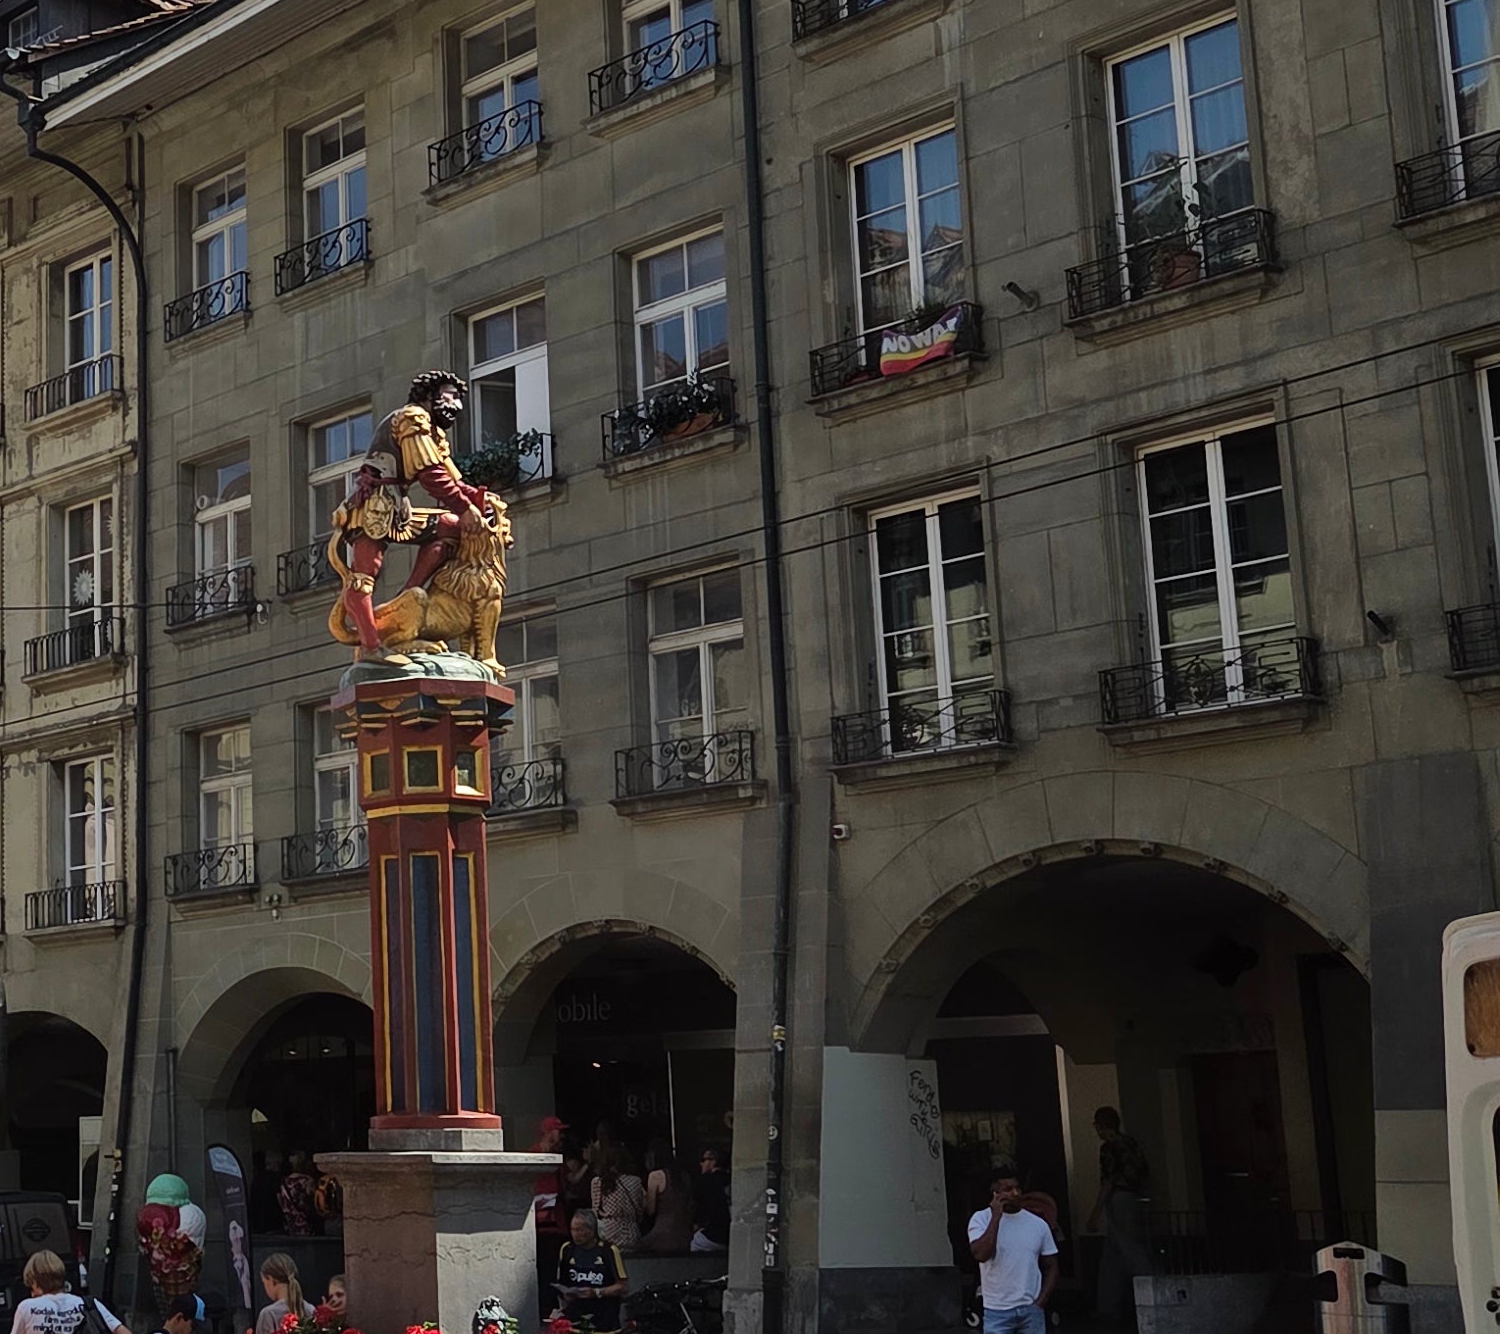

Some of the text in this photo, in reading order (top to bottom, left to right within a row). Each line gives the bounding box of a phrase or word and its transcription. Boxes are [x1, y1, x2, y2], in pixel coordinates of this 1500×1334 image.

[881, 335, 911, 354] NO
[557, 992, 611, 1023] obile
[31, 1307, 55, 1315] Kodak
